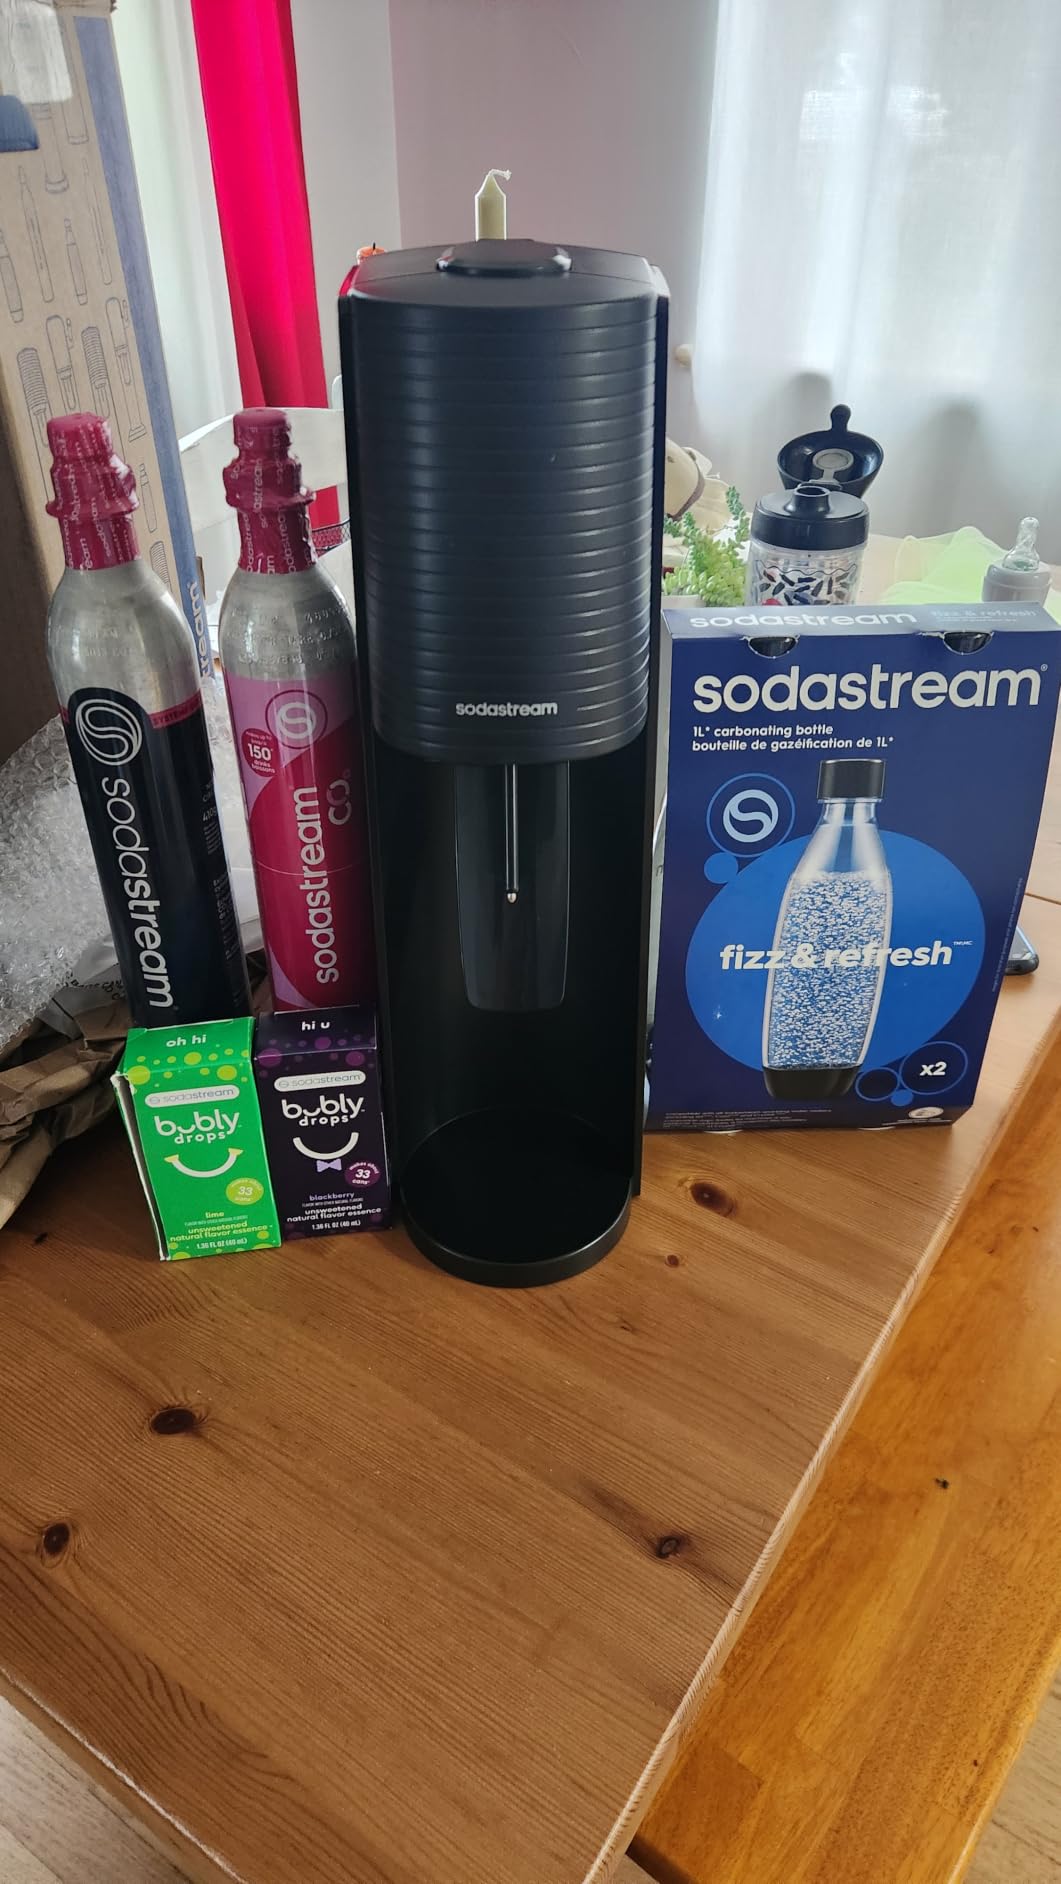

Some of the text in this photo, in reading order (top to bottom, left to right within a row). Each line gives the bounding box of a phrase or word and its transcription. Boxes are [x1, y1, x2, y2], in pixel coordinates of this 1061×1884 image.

[690, 612, 917, 628] sodastream
[455, 702, 558, 717] sodastream
[714, 726, 792, 739] carbonating
[796, 724, 834, 735] bottle
[692, 740, 748, 752] bouteille
[752, 741, 767, 751] de
[771, 738, 853, 753] gazéification
[856, 738, 873, 749] de
[101, 777, 174, 1009] sodastream
[293, 786, 339, 985] sodastream
[719, 940, 953, 970] fizz & refresh
[302, 1021, 316, 1031] hi
[166, 1034, 207, 1048] oh hi
[919, 1061, 947, 1077] x2
[292, 1074, 362, 1087] sodastream
[163, 1088, 235, 1103] sodastream
[281, 1093, 364, 1119] bubly
[154, 1109, 240, 1137] bubly
[299, 1115, 349, 1127] drops
[174, 1132, 226, 1144] drops
[355, 1169, 371, 1179] 33
[238, 1186, 253, 1196] 33
[309, 1192, 355, 1202] blackberry
[286, 1207, 382, 1223] natural flavor essence
[304, 1203, 363, 1215] unsweetened
[170, 1223, 268, 1243] natural flavor essence
[188, 1220, 248, 1235] unsweetened
